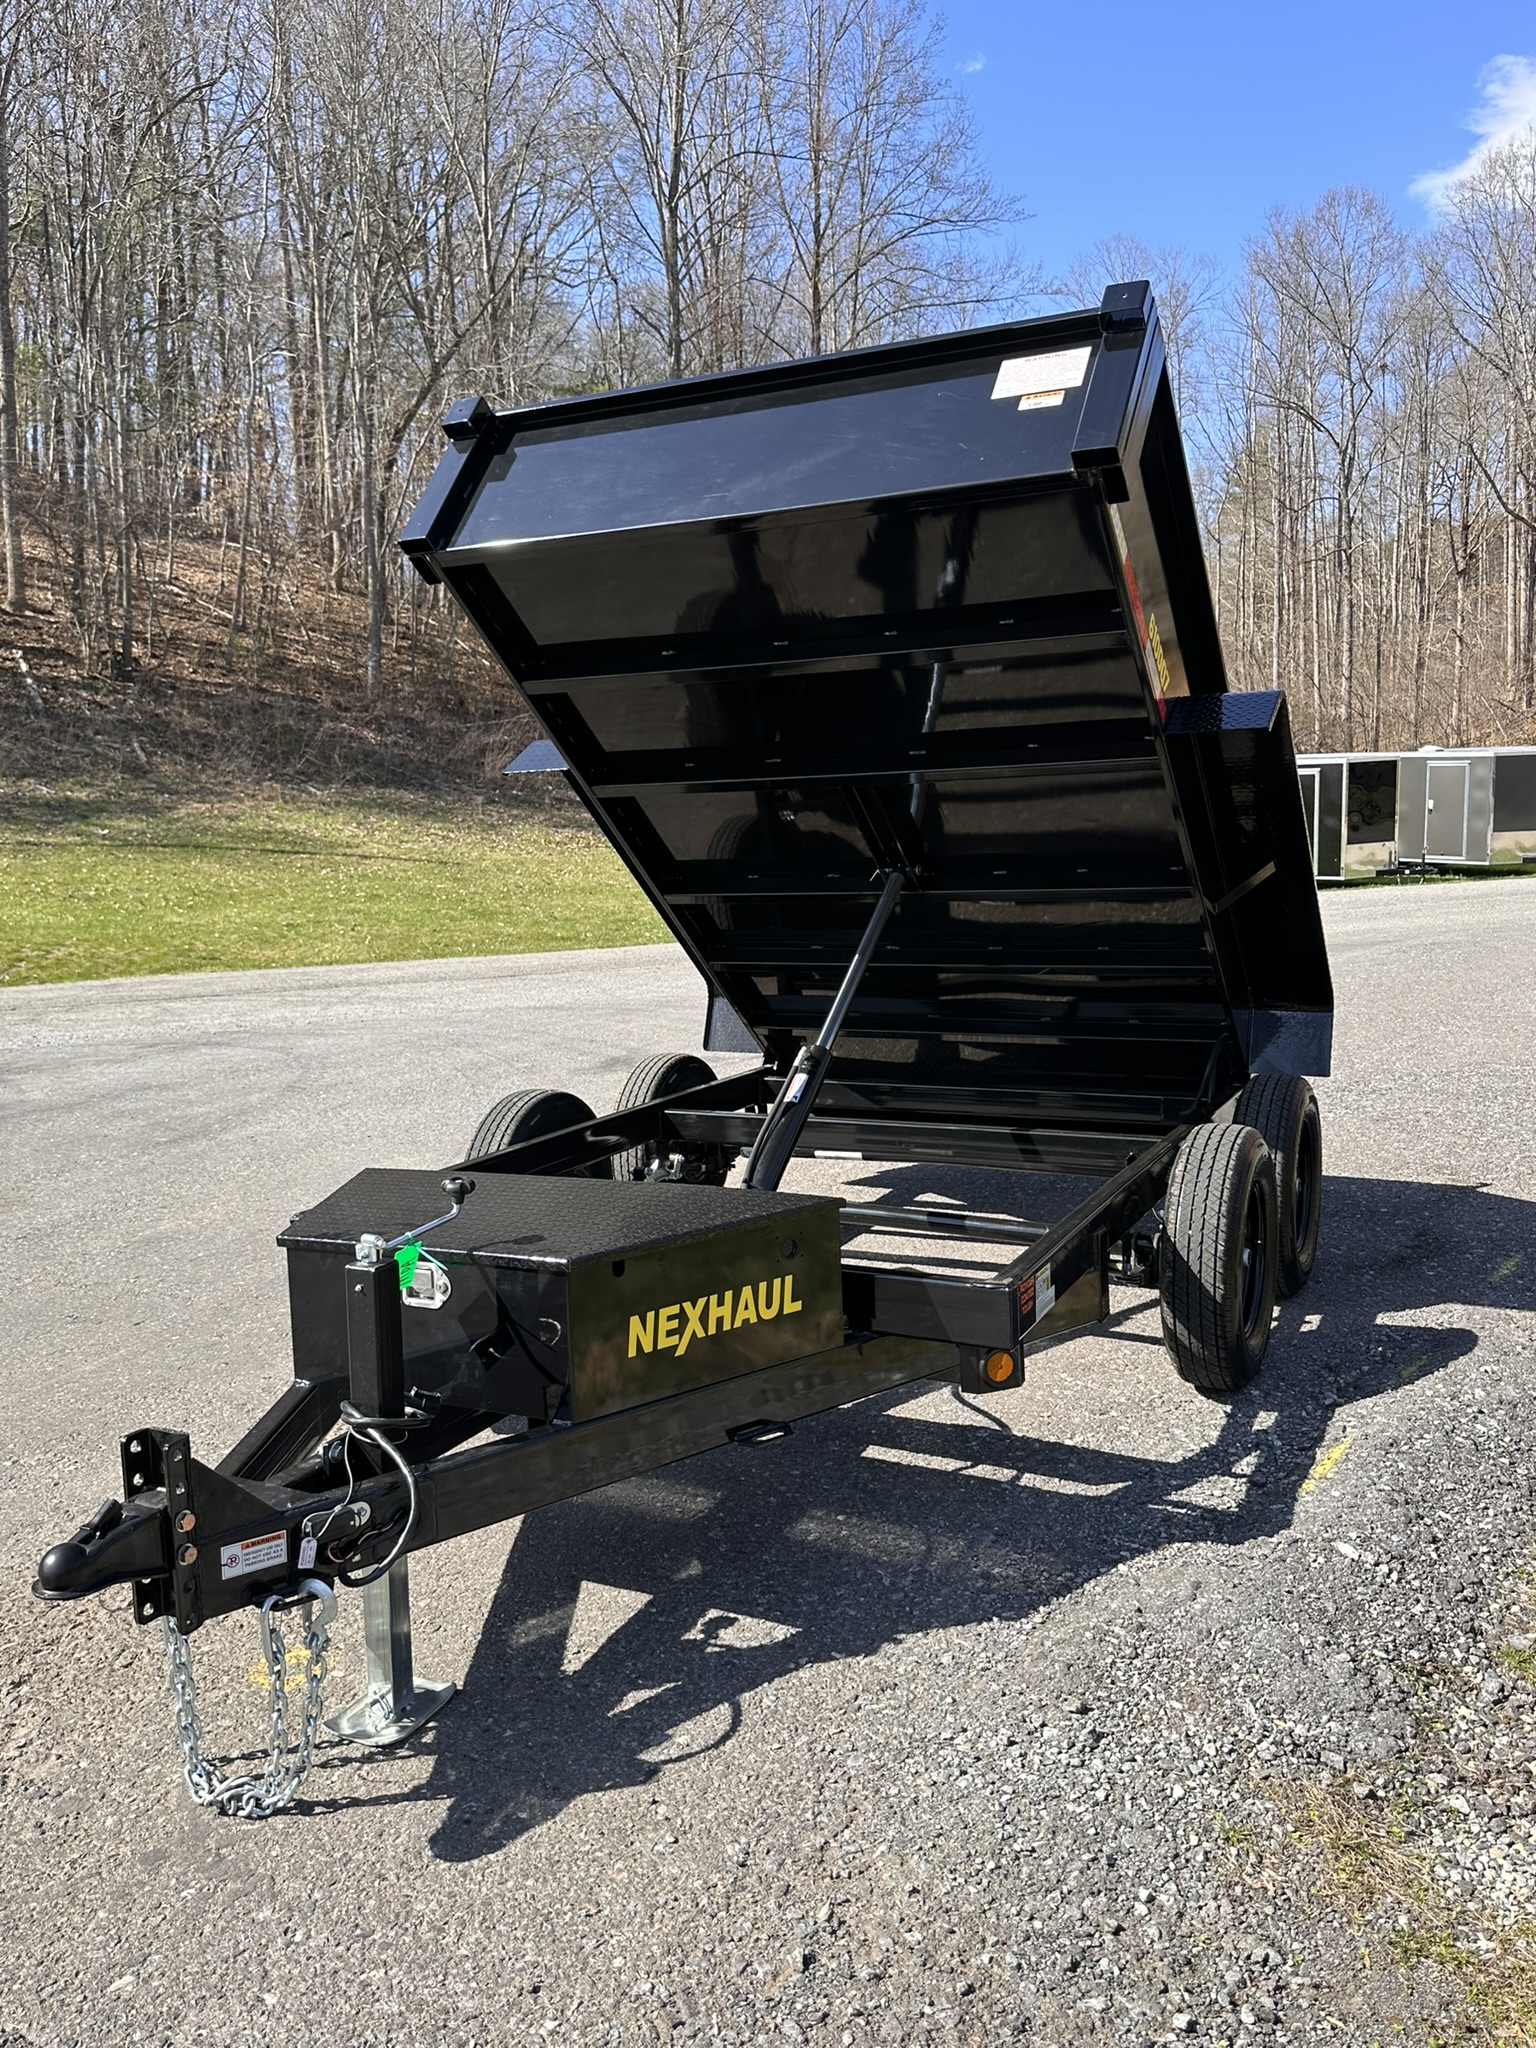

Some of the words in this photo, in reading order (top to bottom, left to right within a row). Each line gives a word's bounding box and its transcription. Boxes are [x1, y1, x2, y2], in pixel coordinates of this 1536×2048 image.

[627, 1273, 803, 1358] NEXHAUL
[251, 1533, 281, 1546] WARNING
[244, 1547, 265, 1557] EMERGENCY
[245, 1558, 265, 1567] PARKING
